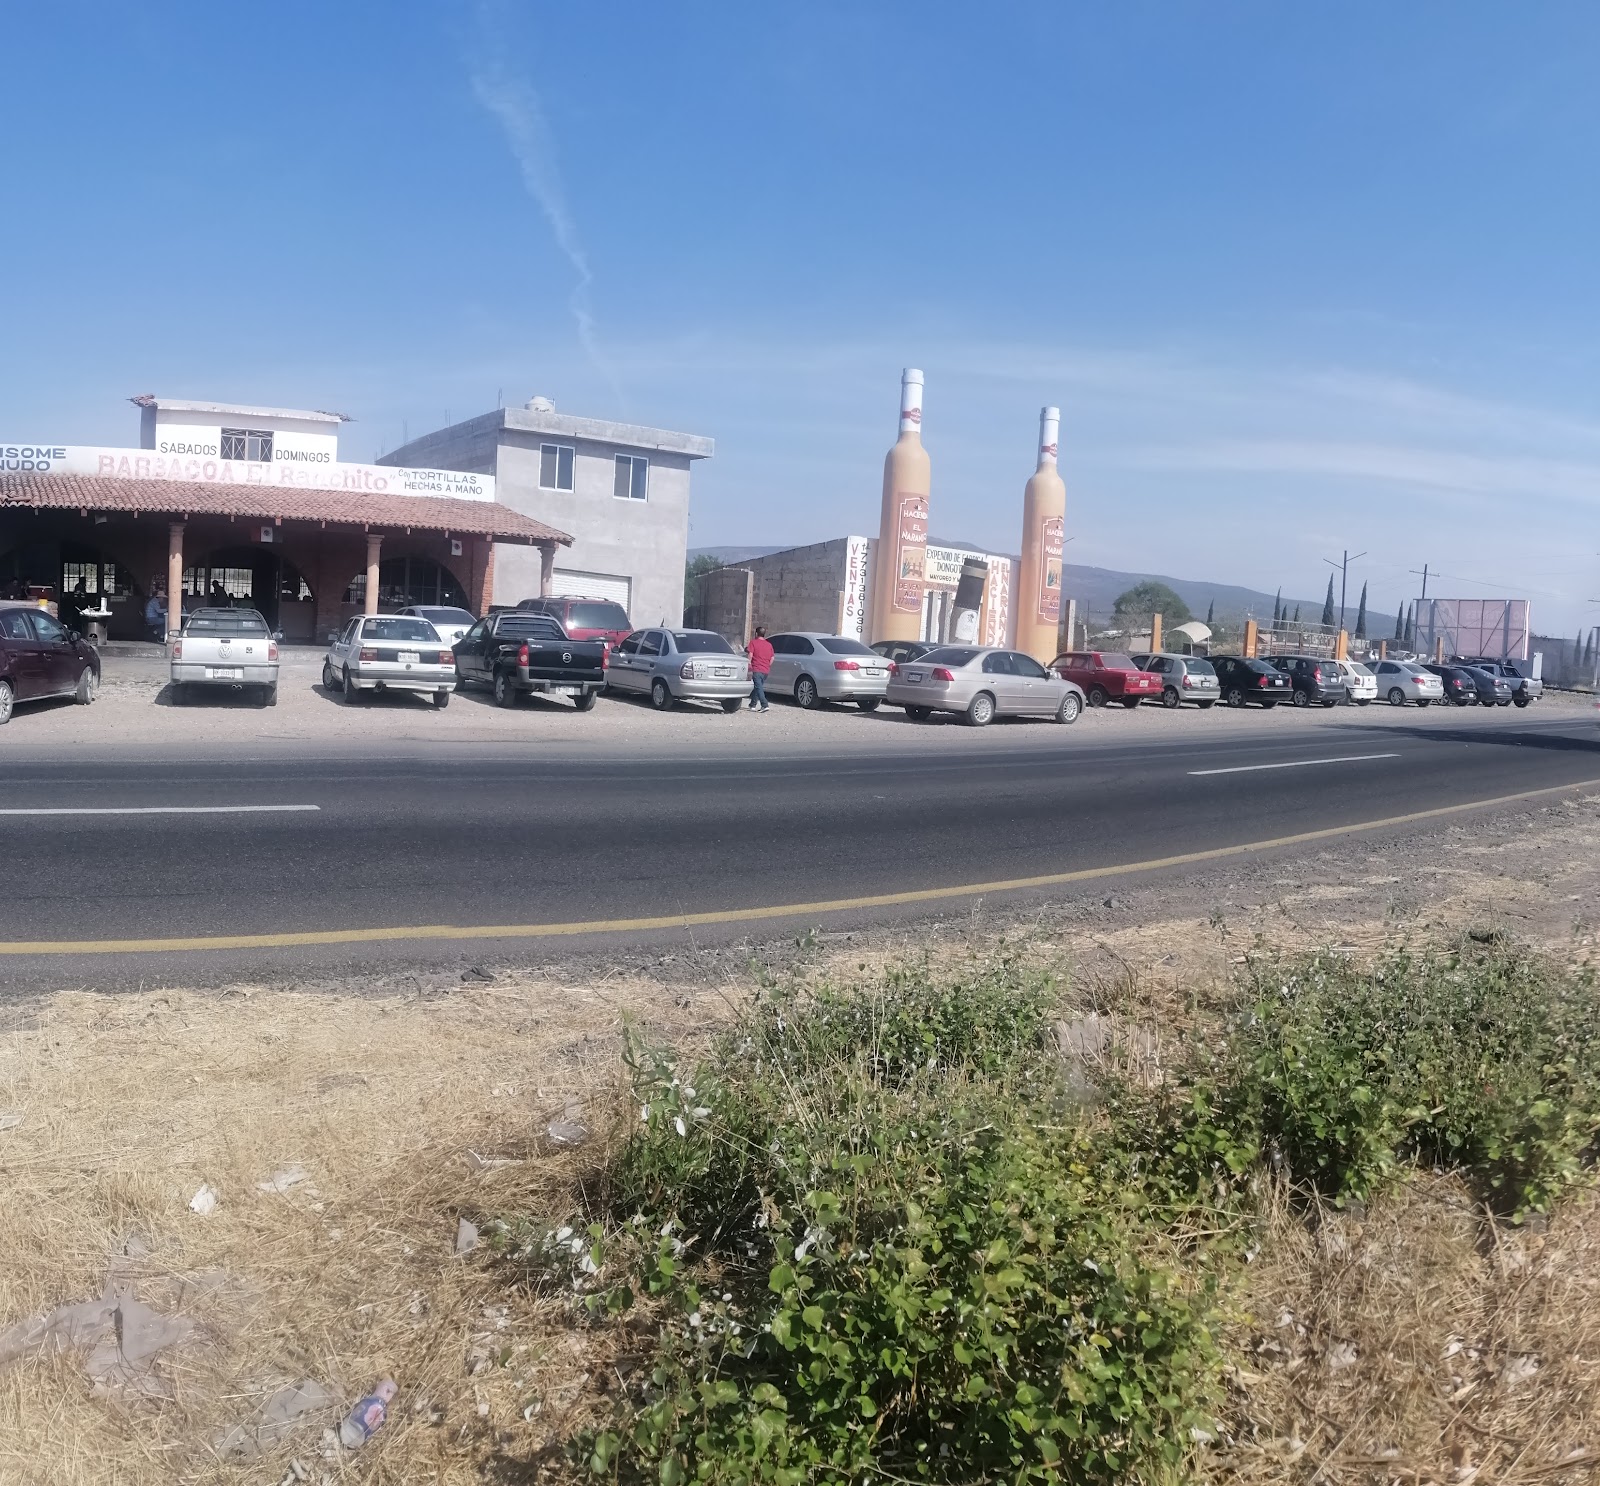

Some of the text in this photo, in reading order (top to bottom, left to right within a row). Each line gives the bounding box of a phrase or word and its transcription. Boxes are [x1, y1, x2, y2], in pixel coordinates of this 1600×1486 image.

[160, 442, 330, 463] SABADOS DOMINGOS
[98, 455, 235, 481] BARBACOA
[412, 472, 477, 484] TORTILLAS
[405, 482, 442, 491] HECHAS
[456, 485, 483, 495] MANO
[846, 543, 859, 616] VENTAS
